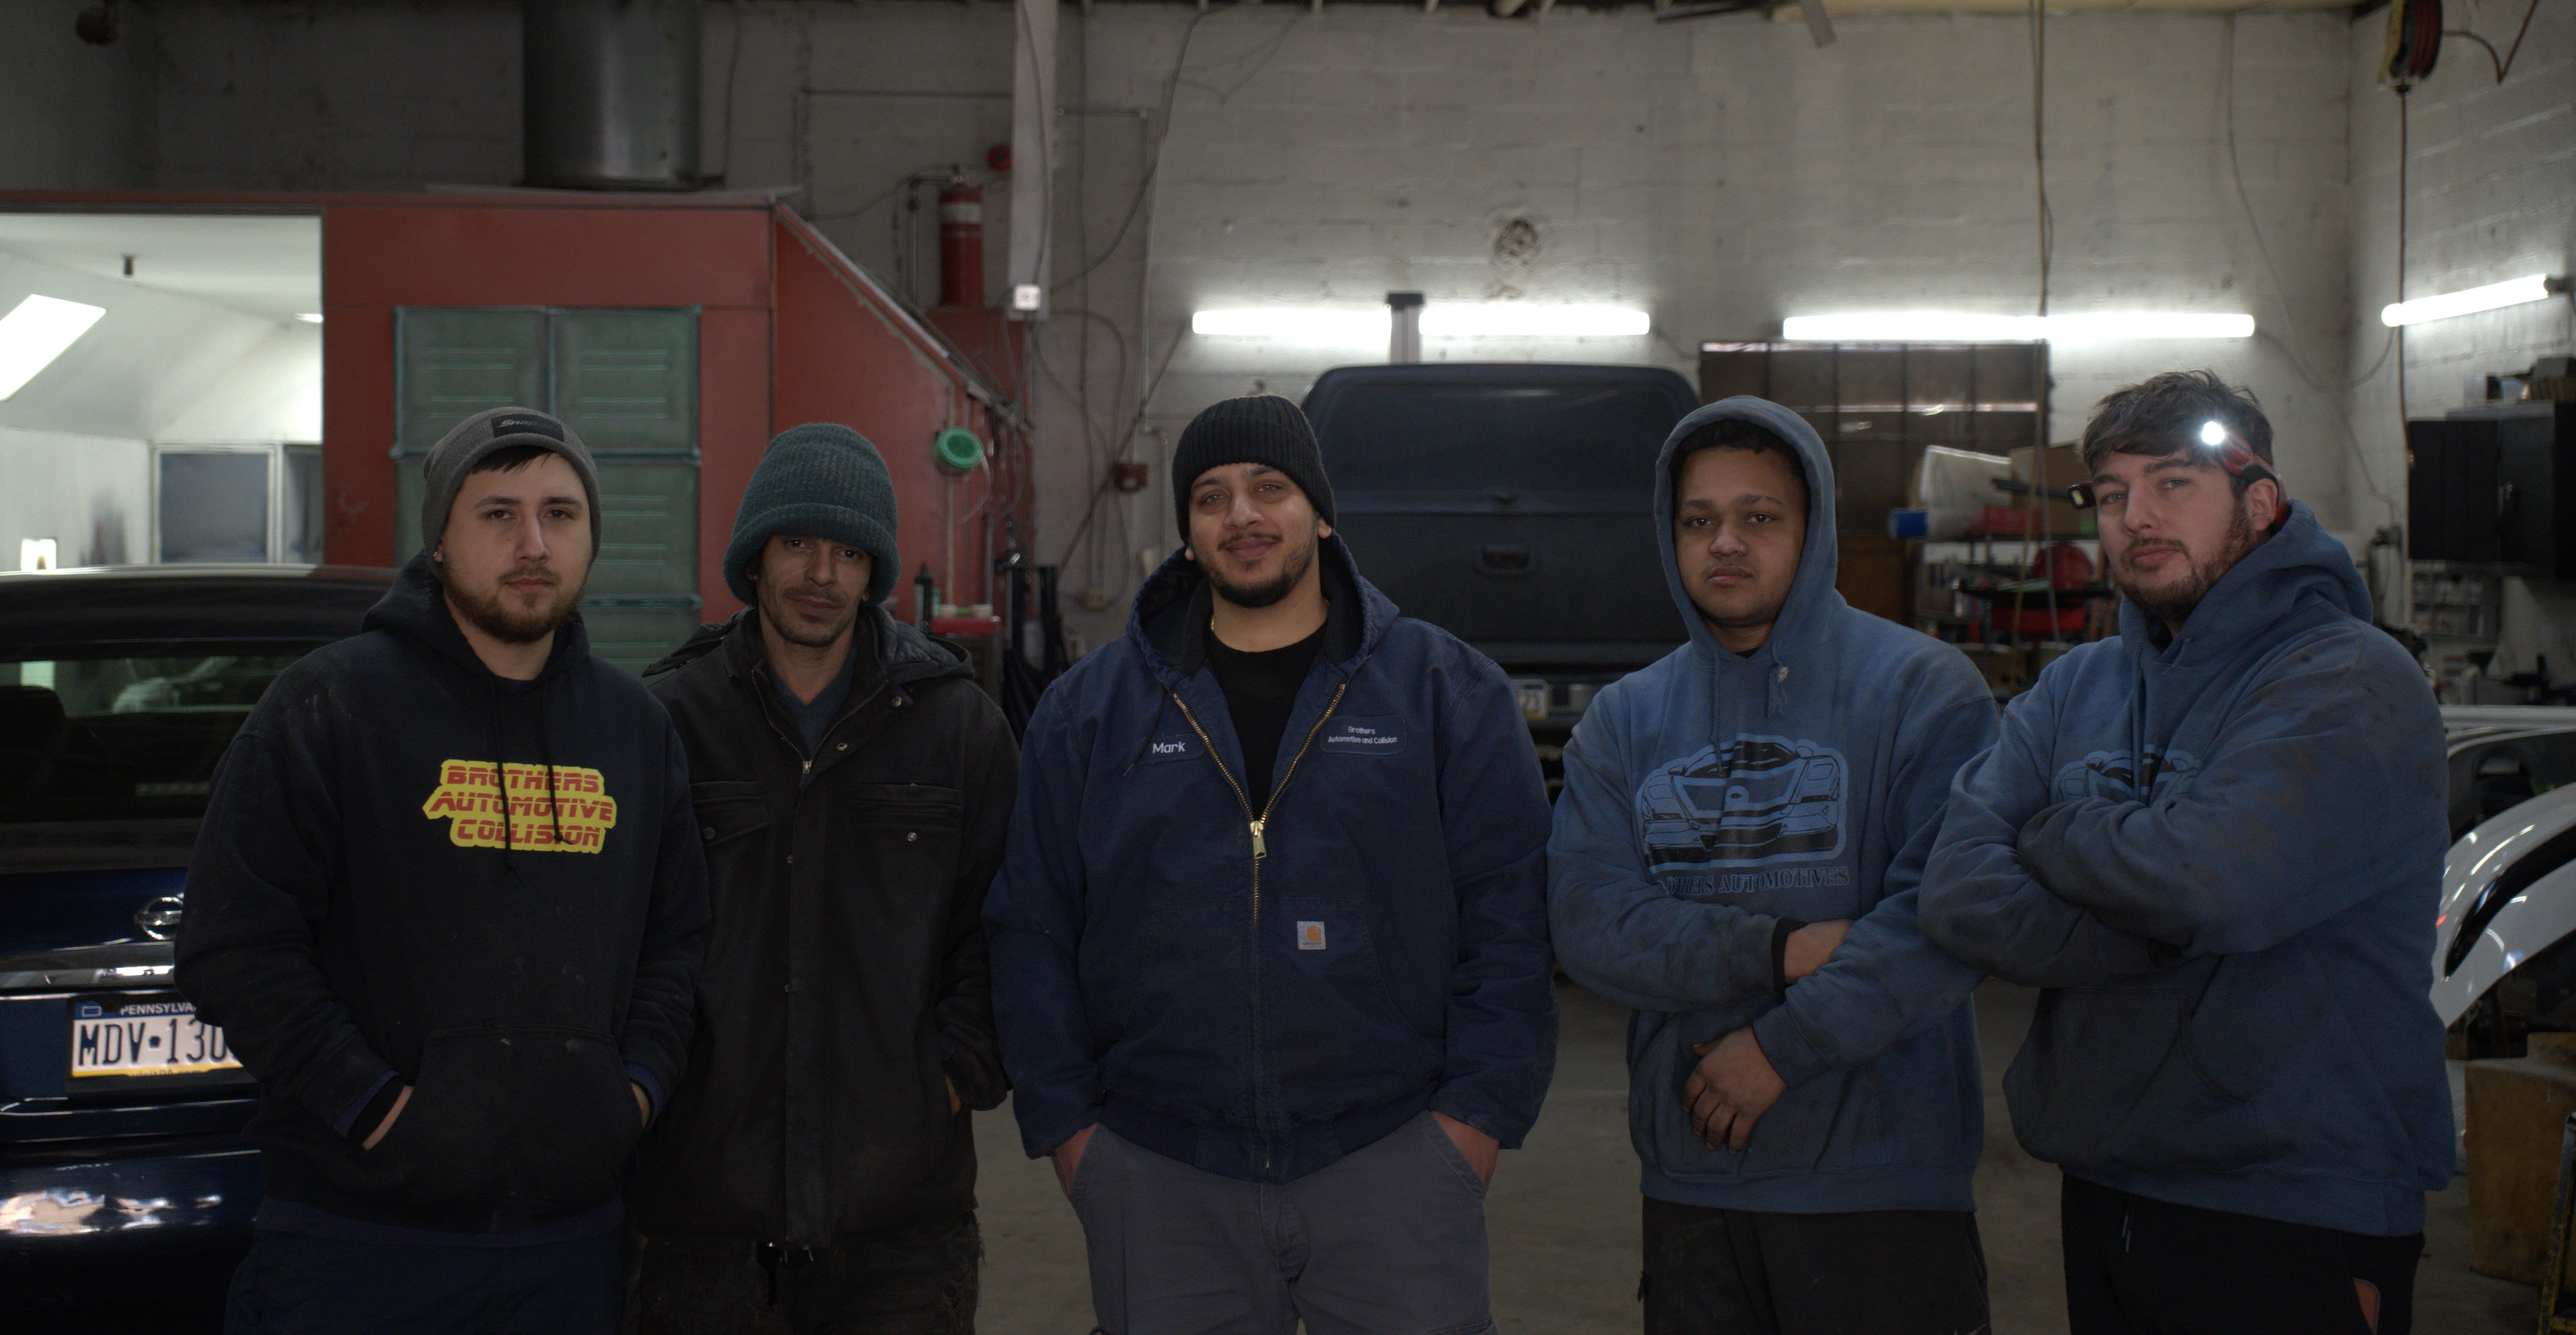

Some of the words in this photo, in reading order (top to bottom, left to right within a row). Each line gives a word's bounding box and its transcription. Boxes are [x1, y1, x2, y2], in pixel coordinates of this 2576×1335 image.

[1348, 726, 1376, 734] Brothers
[1374, 736, 1397, 744] Collision
[1152, 741, 1185, 754] Mark
[447, 765, 599, 794] BROTHERS
[429, 791, 613, 821] AUTOMOTIVE
[1718, 866, 1849, 893] AUTOMOTIVES
[120, 1002, 196, 1016] PENNSYLVA
